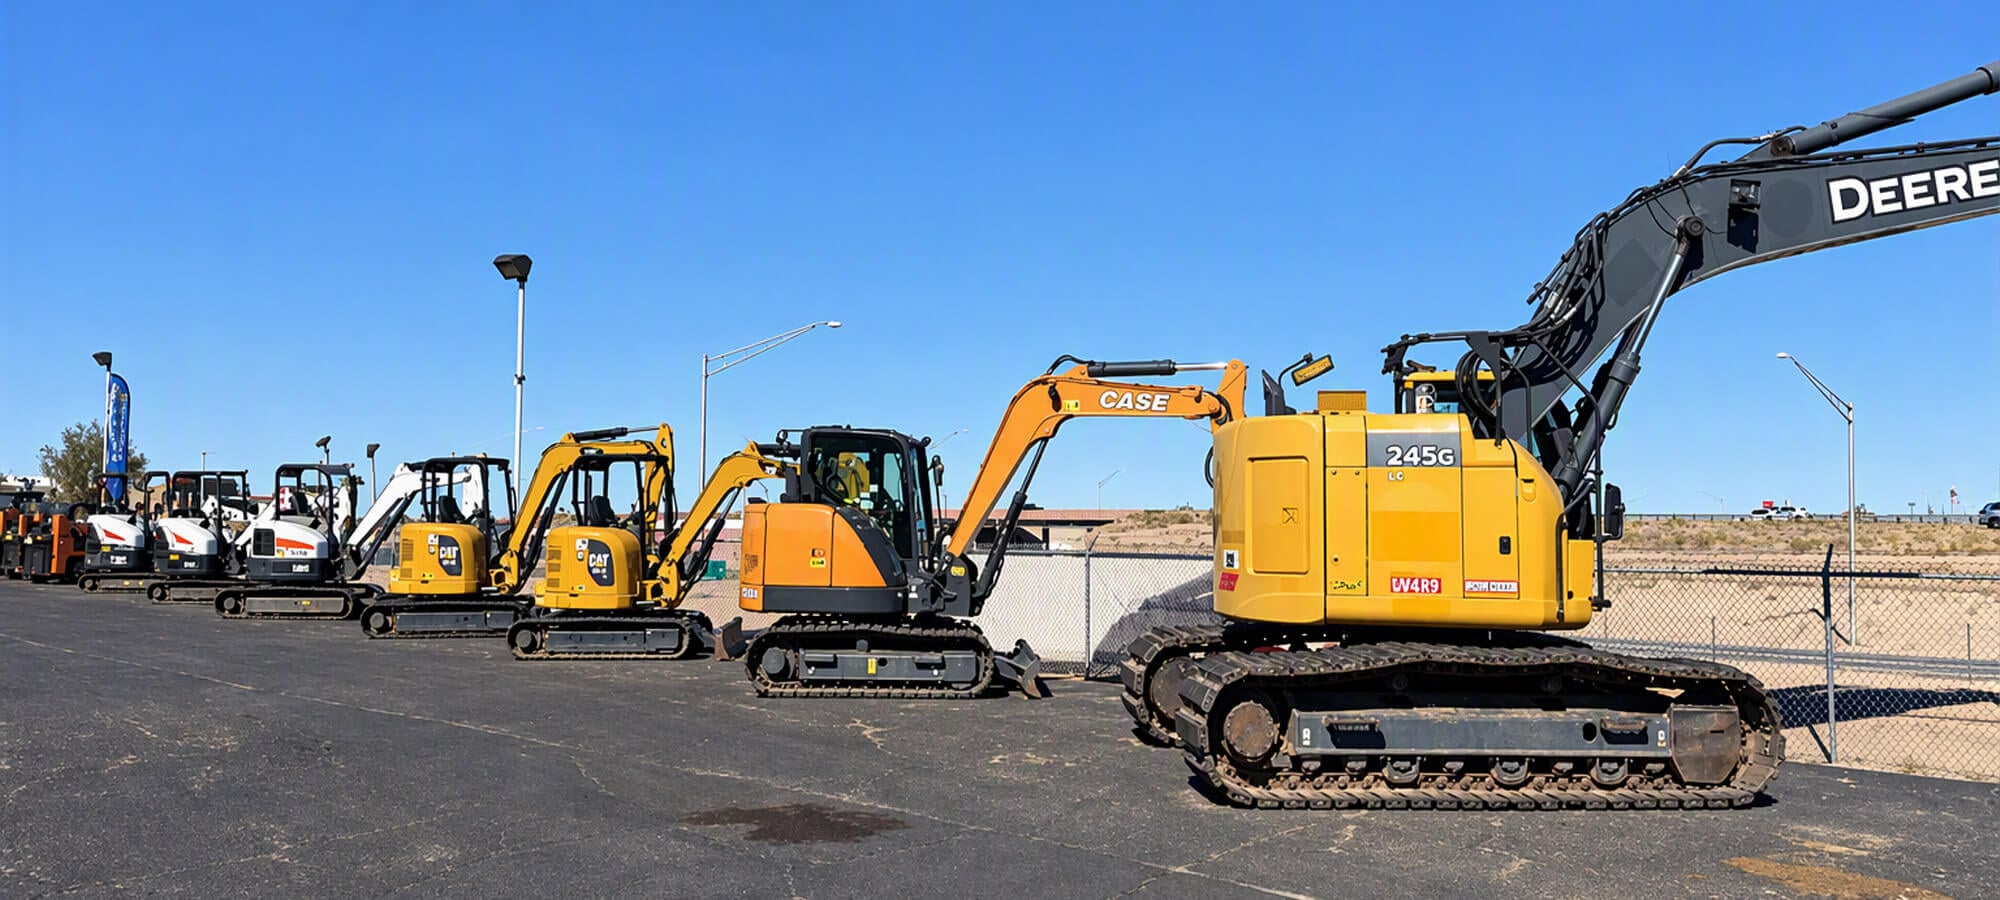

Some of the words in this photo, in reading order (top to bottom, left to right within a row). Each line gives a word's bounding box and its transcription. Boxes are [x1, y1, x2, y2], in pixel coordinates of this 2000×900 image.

[1827, 158, 2000, 223] DEERE
[1099, 390, 1170, 412] CASE
[1386, 444, 1456, 467] 245G
[1388, 471, 1404, 481] LC
[589, 553, 610, 567] CAT
